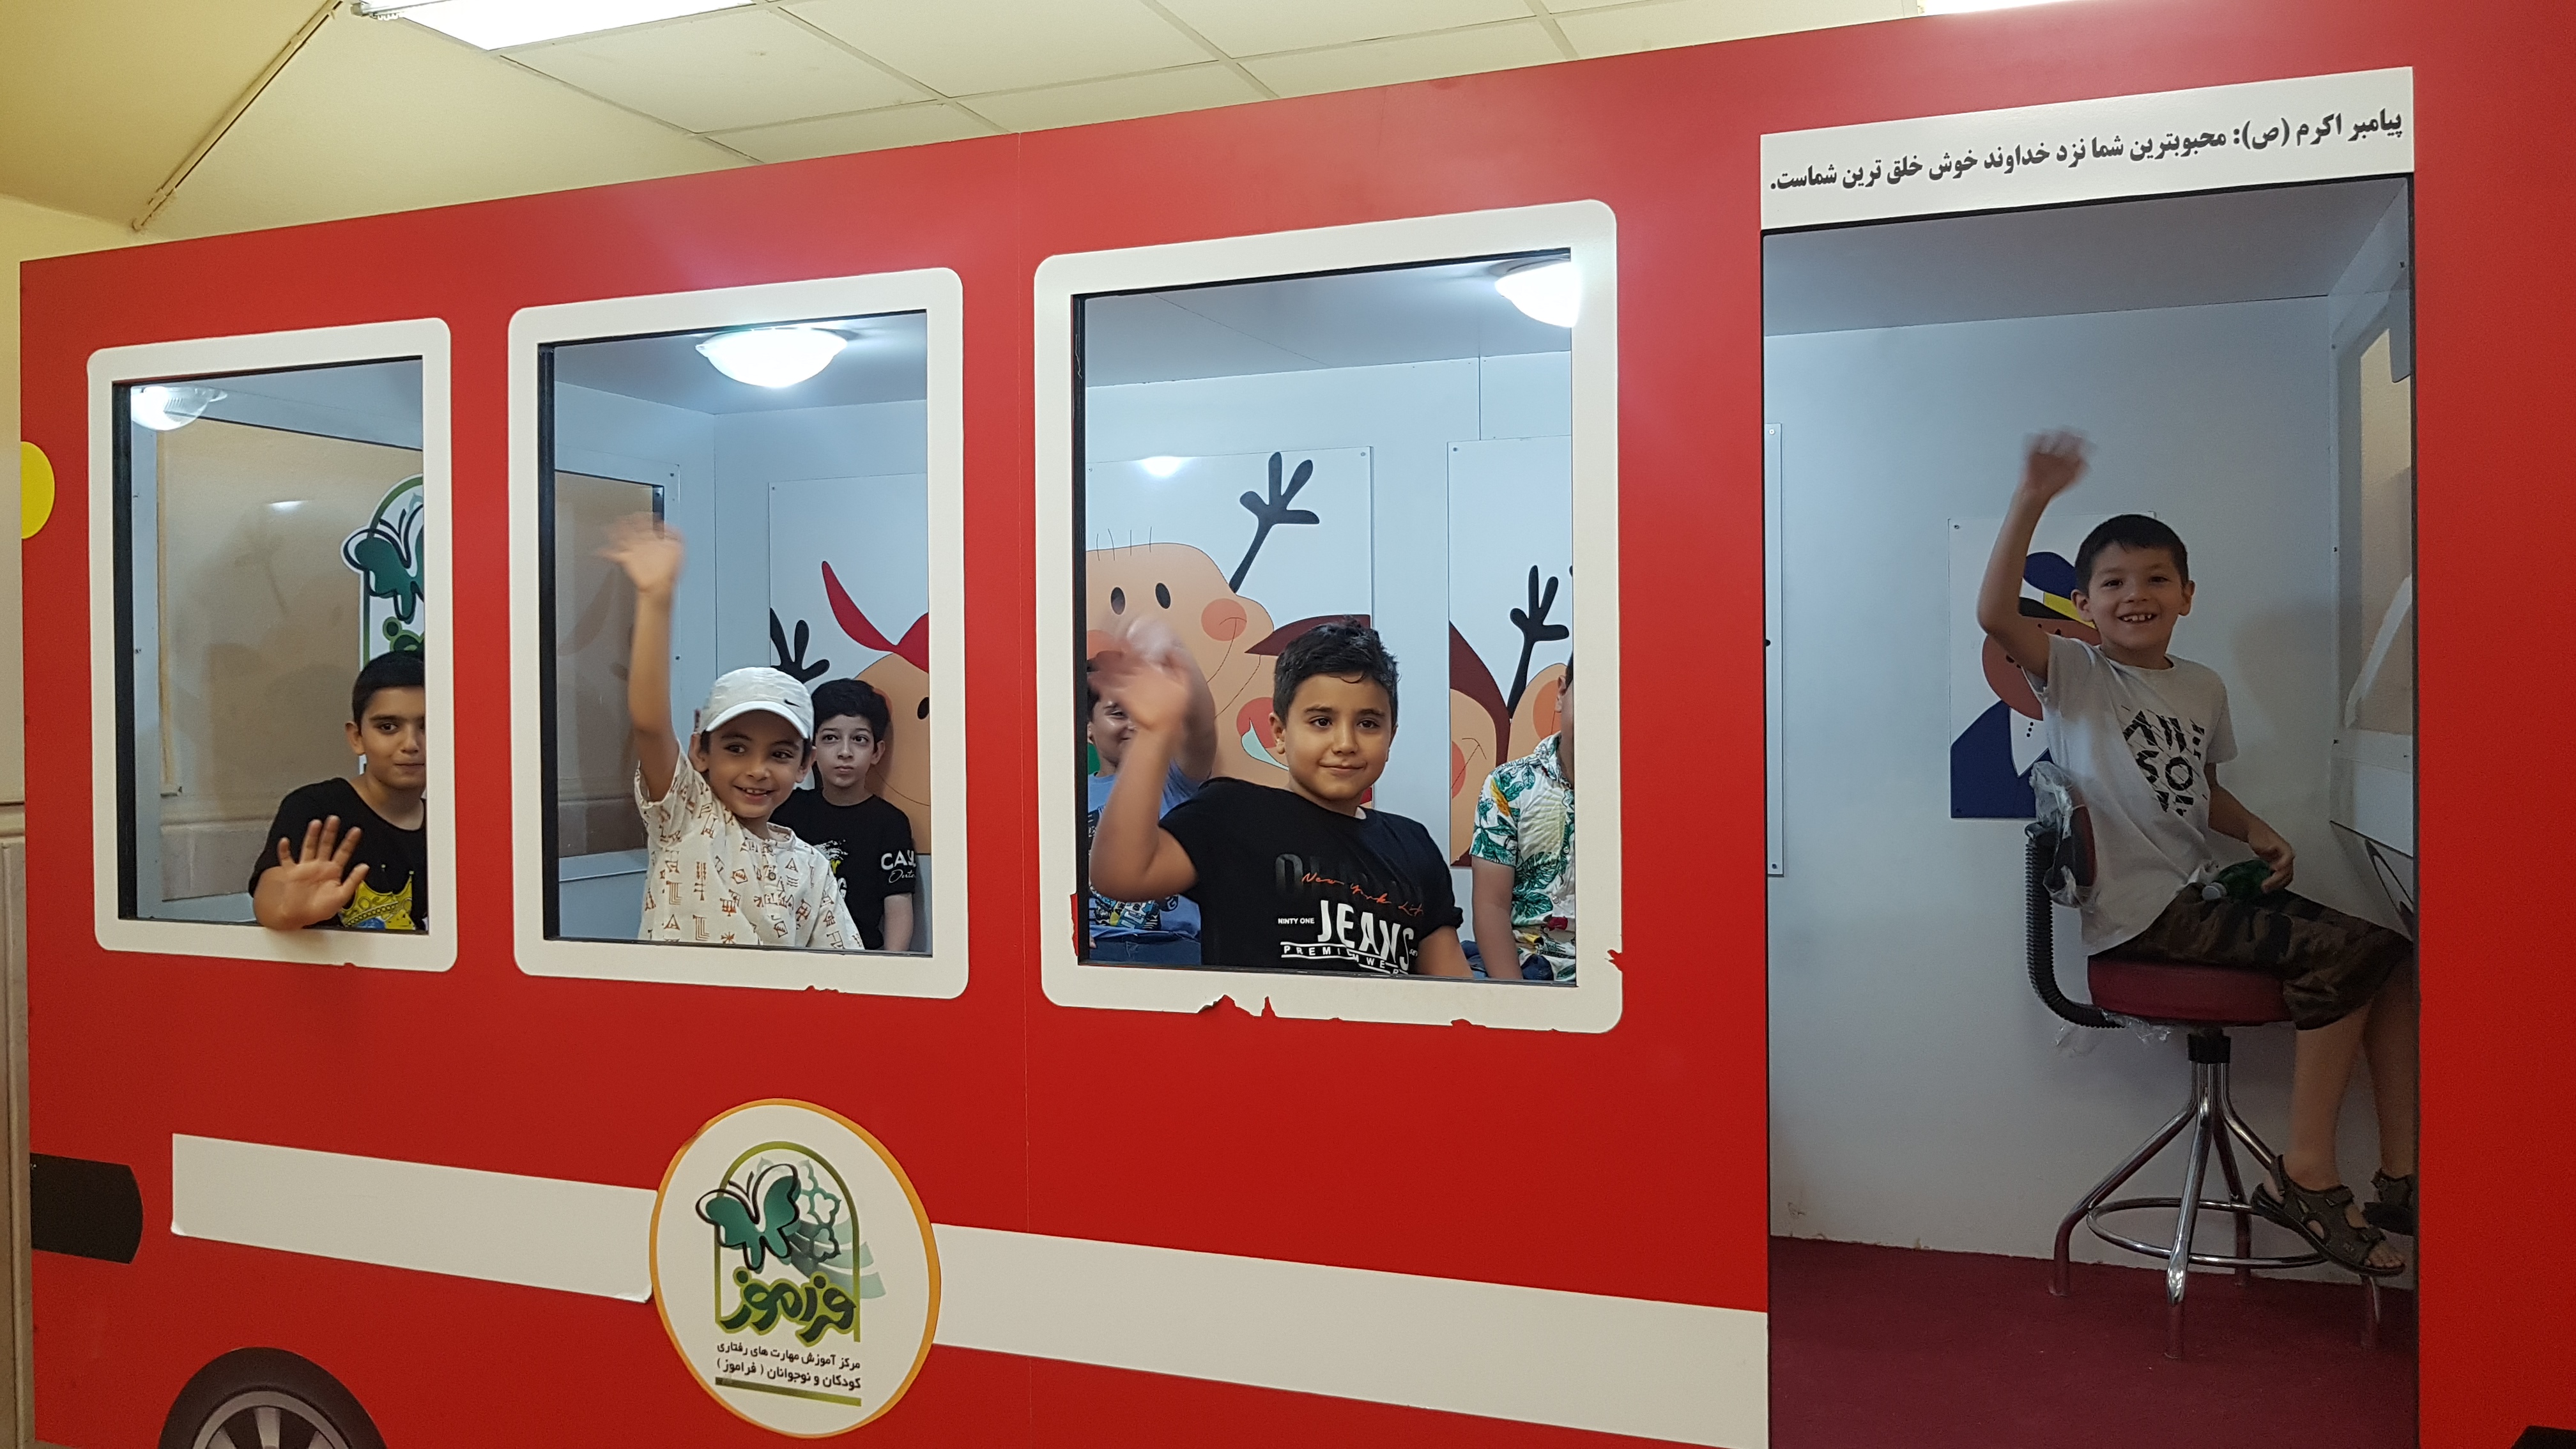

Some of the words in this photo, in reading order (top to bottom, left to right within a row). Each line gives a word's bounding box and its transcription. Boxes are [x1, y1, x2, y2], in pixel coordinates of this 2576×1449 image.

[2297, 112, 2342, 146] اکرم
[2347, 108, 2402, 142] پیامبر
[1984, 143, 2050, 174] خداوند
[2056, 138, 2086, 168] نزد
[2092, 135, 2124, 158] شما
[2129, 130, 2227, 162] محبوبترین
[1770, 164, 1837, 190] شماست.
[1843, 158, 1881, 188] ترین
[1887, 155, 1923, 185] خلق
[1929, 149, 1978, 181] خوش
[1317, 900, 1414, 971] JEANS
[717, 1342, 747, 1356] رفتاری
[750, 1346, 768, 1358] های
[770, 1349, 799, 1363] مهارت
[801, 1352, 836, 1367] آموزش
[767, 1367, 811, 1384] نوجوانان
[839, 1357, 861, 1371] مرکز
[813, 1375, 820, 1386] و
[823, 1374, 861, 1391] کودکان
